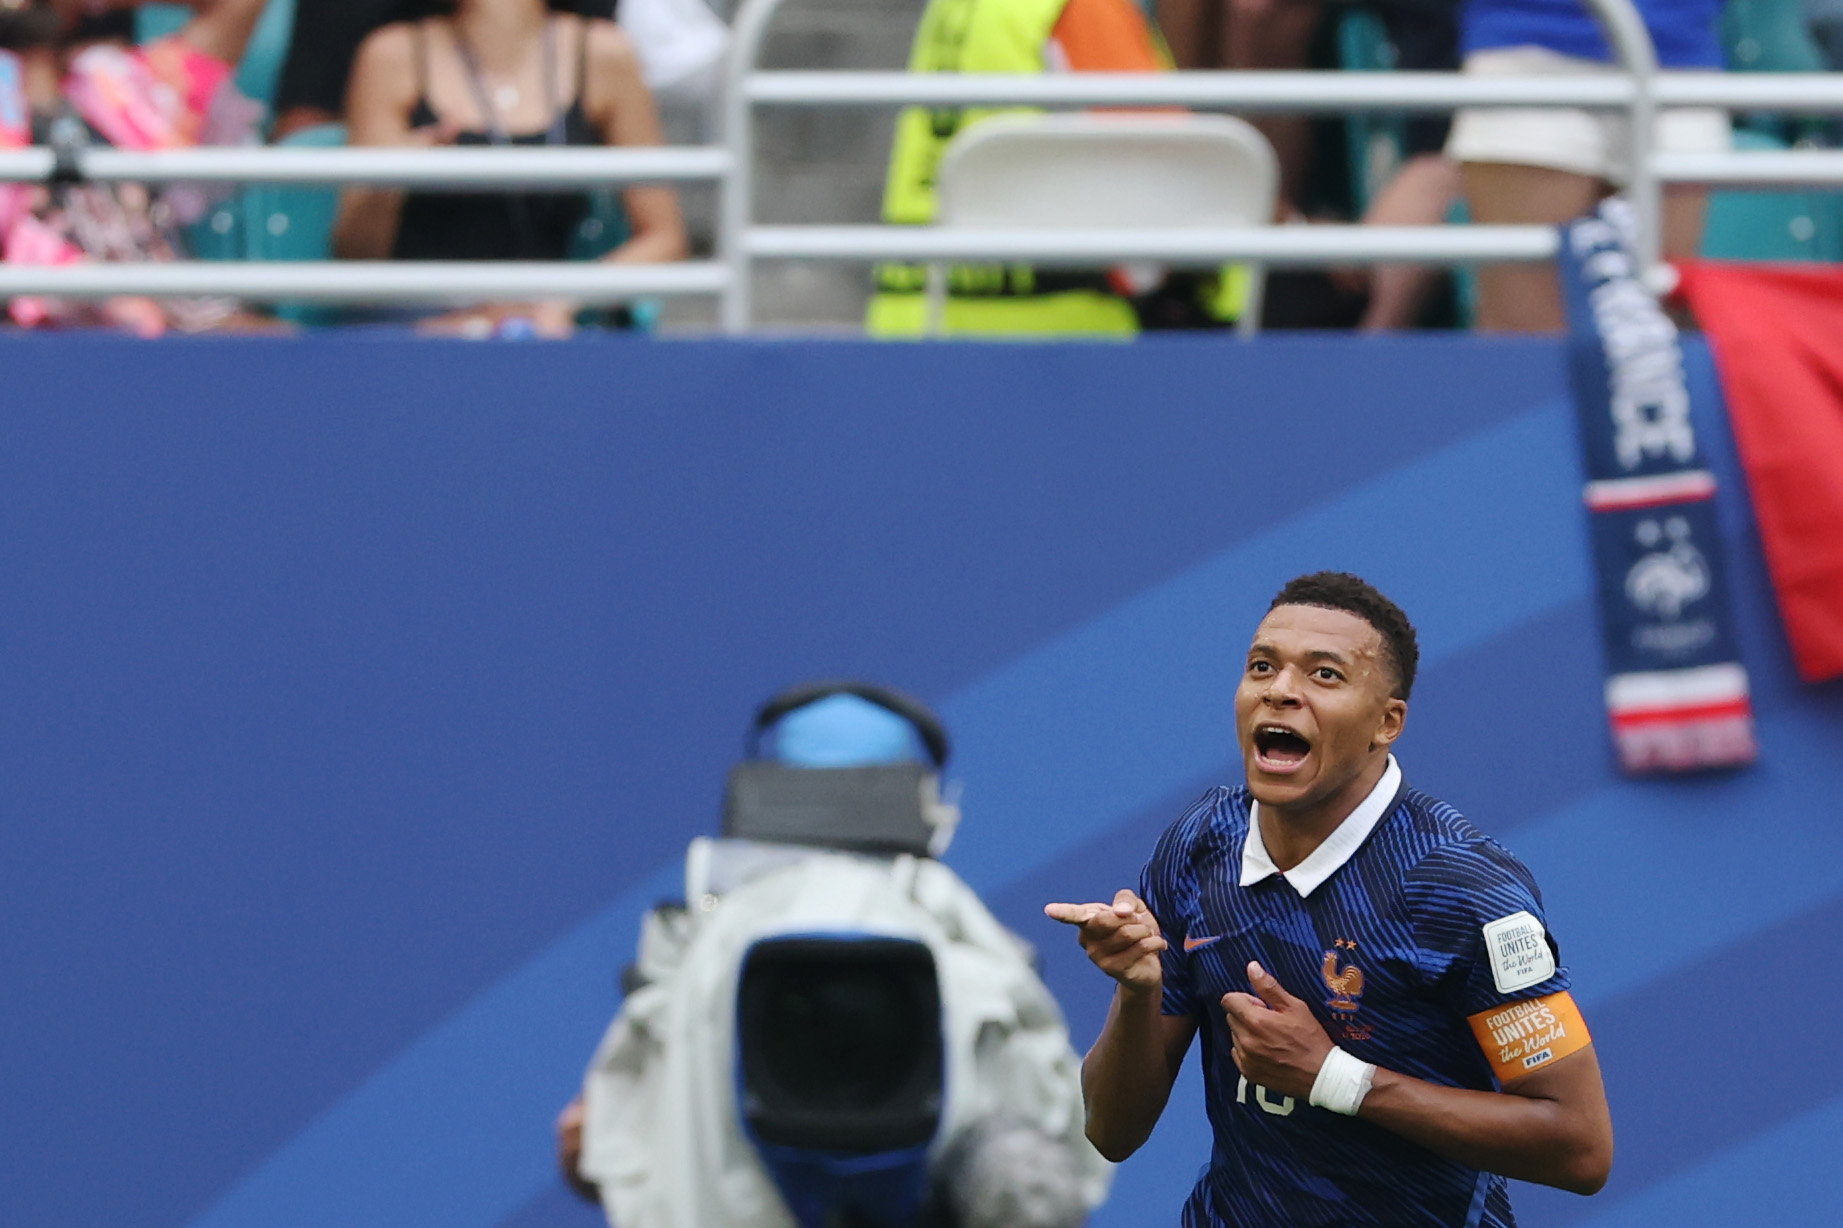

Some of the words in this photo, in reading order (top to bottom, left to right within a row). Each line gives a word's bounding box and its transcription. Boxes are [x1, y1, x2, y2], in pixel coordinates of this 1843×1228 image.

[1497, 924, 1534, 944] FOOTBALL
[1500, 933, 1538, 958] UNITES
[1502, 958, 1517, 971] the
[1517, 948, 1543, 966] World
[1517, 966, 1533, 976] FIFA
[1486, 998, 1546, 1030] FOOTBALL
[1492, 1007, 1556, 1047] UNITES
[1498, 1045, 1522, 1063] the
[1522, 1021, 1566, 1053] World
[1525, 1051, 1550, 1066] FIFA
